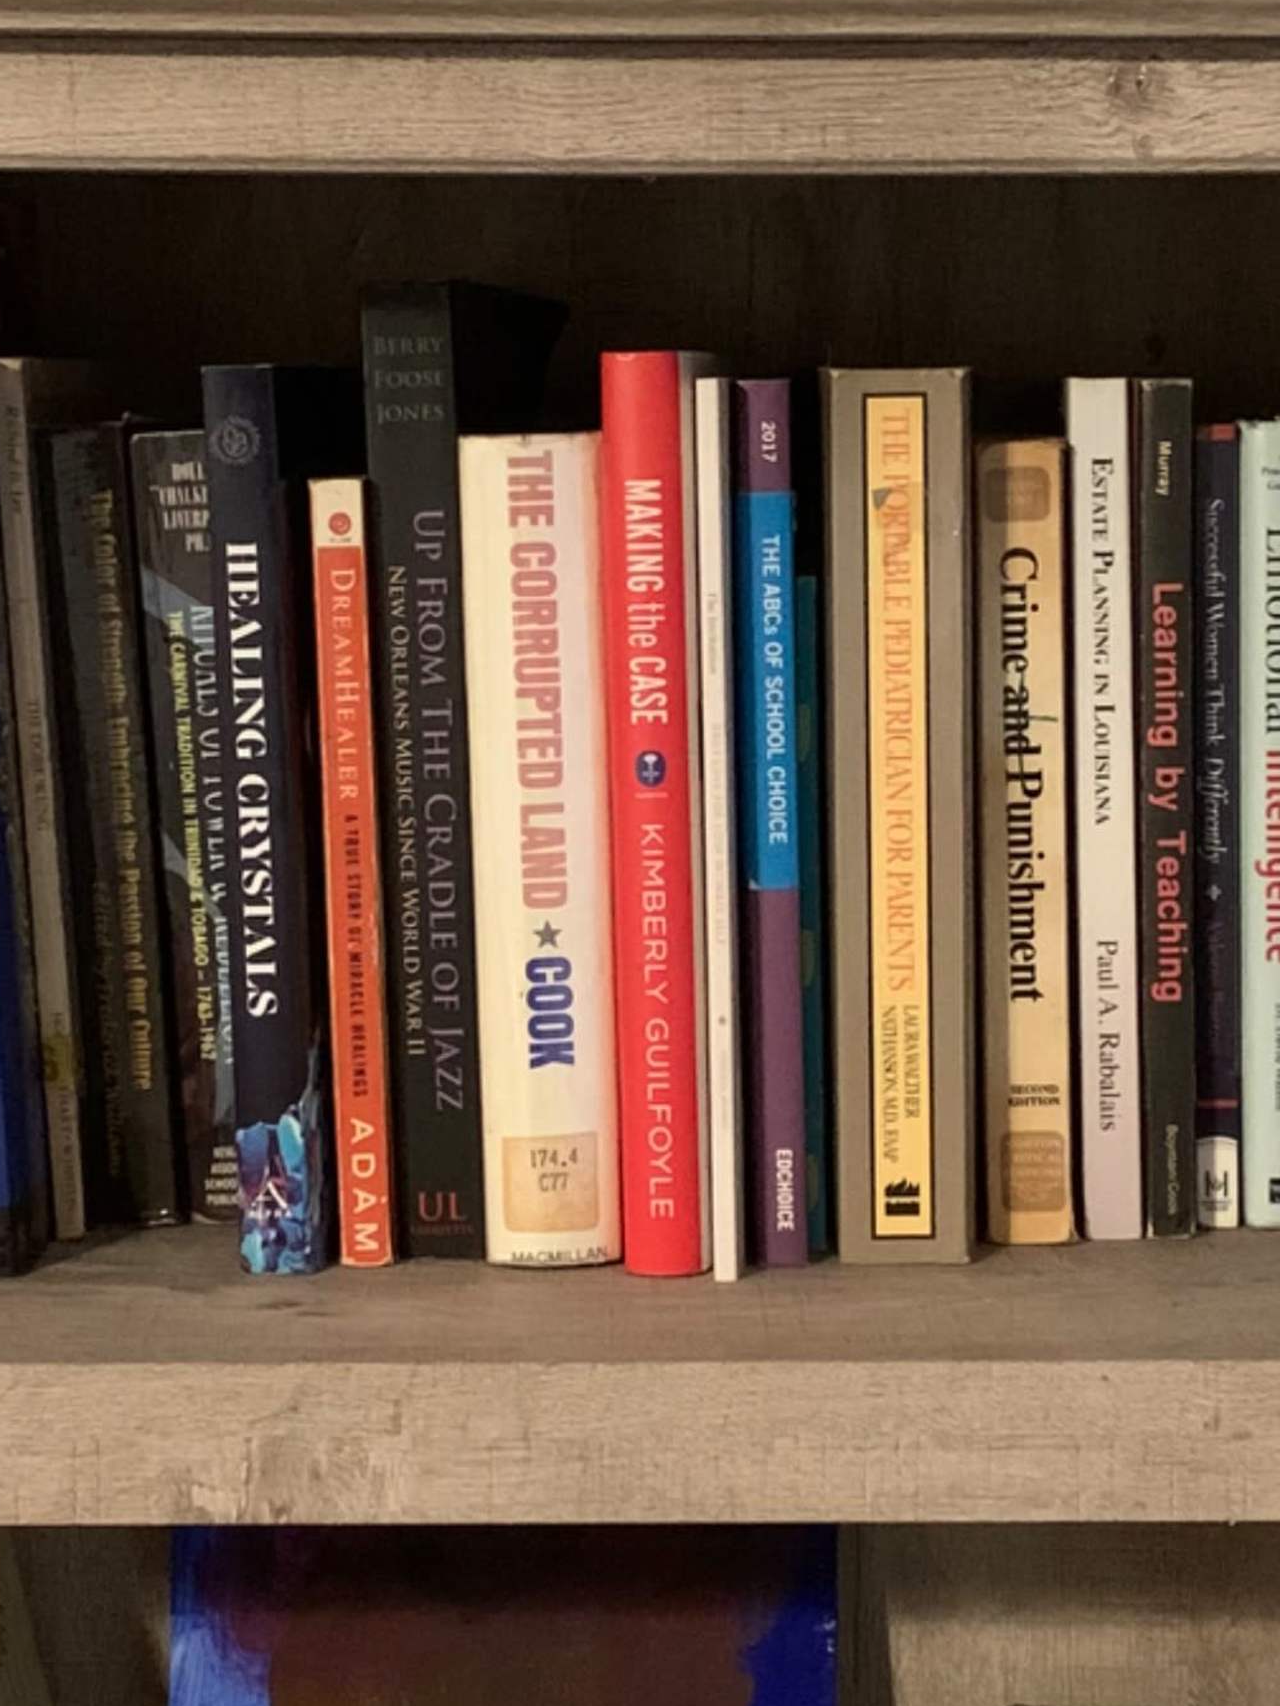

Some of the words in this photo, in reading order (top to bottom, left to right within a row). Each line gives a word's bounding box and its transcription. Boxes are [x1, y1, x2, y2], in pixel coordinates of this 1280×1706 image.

[372, 335, 441, 356] BERRY
[759, 420, 779, 464] 2017
[880, 410, 913, 467] THE
[1153, 440, 1173, 496] Murray
[507, 449, 555, 527] THE
[1090, 456, 1115, 542] ESTATE
[412, 509, 447, 561] UP
[622, 477, 664, 593] MAKING
[761, 534, 782, 576] THE
[1203, 497, 1227, 598] Successful
[166, 610, 184, 638] THE
[387, 565, 410, 618] NEW
[626, 600, 665, 649] the
[763, 582, 784, 636] ABCs
[999, 546, 1039, 674] Crime
[1091, 549, 1117, 667] PLANNING
[225, 541, 267, 760] HEALING
[416, 577, 449, 685] FROM
[509, 540, 564, 790] CORRUPTED
[764, 641, 785, 669] OF
[1148, 581, 1186, 748] Learning
[1203, 601, 1226, 681] Women
[389, 624, 412, 729] ORLEANS
[628, 655, 668, 725] CASE
[883, 618, 918, 802] PEDIATRICIAN
[1093, 672, 1111, 695] IN
[1204, 683, 1226, 747] Think
[176, 716, 195, 793] TRADITION
[420, 698, 455, 780] THE
[764, 674, 788, 760] SCHOOL
[1002, 684, 1041, 756] and
[394, 737, 416, 805] MUSIC
[1093, 703, 1117, 827] LOUISIANA
[1149, 765, 1188, 812] by
[766, 766, 789, 845] CHOICE
[884, 807, 915, 863] FOR
[1199, 756, 1230, 864] Differently
[184, 819, 203, 889] TRINIDAD
[343, 828, 360, 866] TRUE
[398, 818, 420, 882] SINCE
[425, 792, 458, 950] CRADLE
[519, 800, 568, 910] LAND
[233, 772, 280, 1018] CRYSTALS
[345, 873, 362, 920] STORY
[638, 822, 668, 1003] KIMBERLY
[1004, 769, 1046, 1003] Punishment
[1150, 829, 1189, 1004] Teaching
[190, 906, 210, 966] TOBAGO
[399, 888, 424, 973] WORLD
[885, 870, 917, 993] PARENTS
[1095, 938, 1120, 991] Paul
[347, 951, 365, 1017] MIRACLE
[404, 980, 426, 1031] WAR
[431, 961, 461, 1011] OF
[524, 955, 576, 1070] COOK
[350, 1023, 368, 1097] HEALINGS
[903, 1004, 919, 1050] LAURA
[428, 1026, 466, 1111] JAZZ
[904, 1051, 920, 1119] WALTHER
[1097, 1031, 1122, 1133] Rabalais
[643, 1016, 676, 1220] GUILFOYLE
[775, 1147, 796, 1232] EDCHOICE
